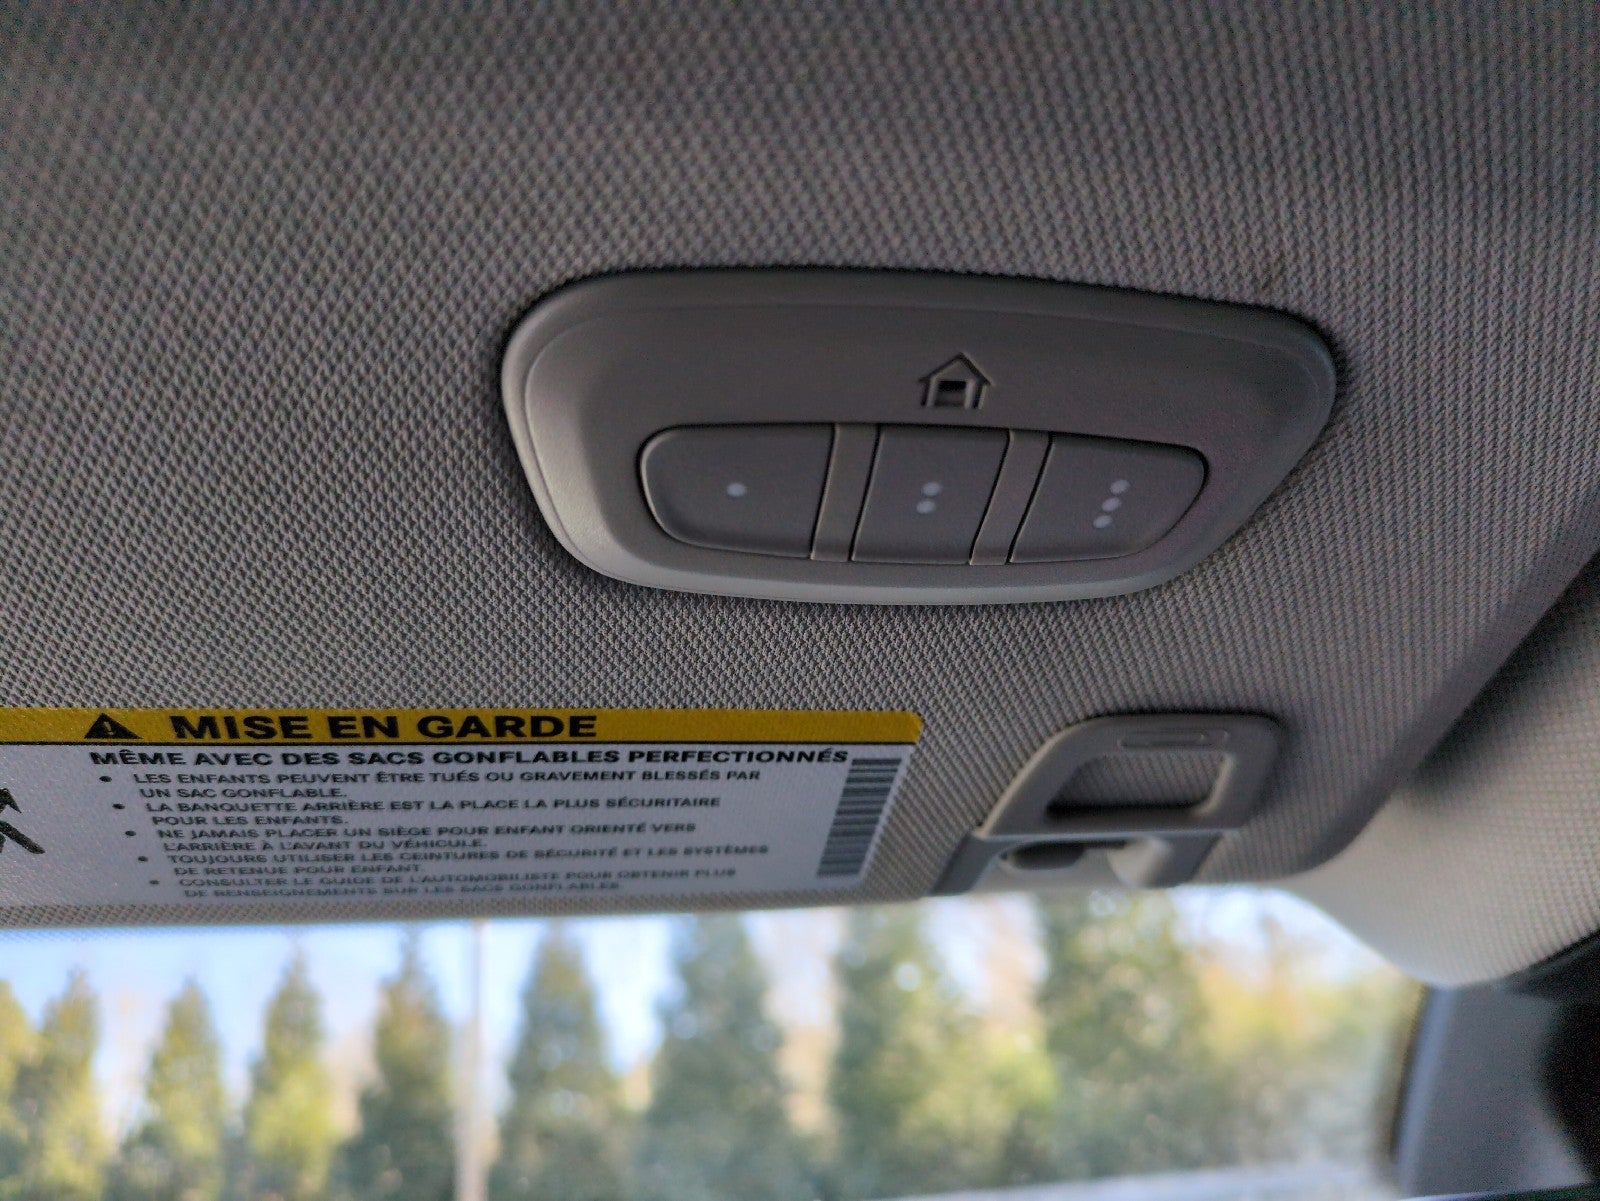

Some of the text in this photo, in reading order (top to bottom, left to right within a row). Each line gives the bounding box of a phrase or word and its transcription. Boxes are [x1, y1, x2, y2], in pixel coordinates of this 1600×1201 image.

[170, 715, 598, 739] MISE EN GARDE
[89, 748, 849, 765] MÊME AVEC DES SACS GONFLABLES PERFECTIONNÉS
[133, 769, 761, 784] LES ENFANTS PEUVENT ÊTRE TUÉS OU GRAVEMENT BLESSÉS PAR
[140, 788, 347, 798] UN SAC GONFLABLE.
[145, 796, 721, 812] LA BANQUETTE ARRIÈRE EST LA PLACE LA PLUS SÉCURITAIRE
[152, 815, 349, 825] POUR LES ENFANTS.
[157, 822, 696, 840] NE JAMAIS PLACER UN SIÈGE POUR ENFANT ORIENTÉ VERS
[263, 839, 274, 850] À
[359, 841, 385, 850] DU
[392, 838, 487, 849] VÉHICULE.
[168, 854, 268, 864] TOUJOURS
[273, 853, 355, 863] UTILISER
[361, 852, 393, 862] LES
[401, 850, 500, 861] CEINTURES
[506, 850, 528, 859] DE
[534, 846, 617, 858] SÉCURITÉ
[623, 848, 641, 857] ET
[648, 847, 678, 857] LES
[174, 867, 199, 876] DE
[205, 867, 288, 876] RETENUE
[295, 866, 345, 875] POUR
[294, 877, 313, 886] LE
[382, 876, 402, 884] DE
